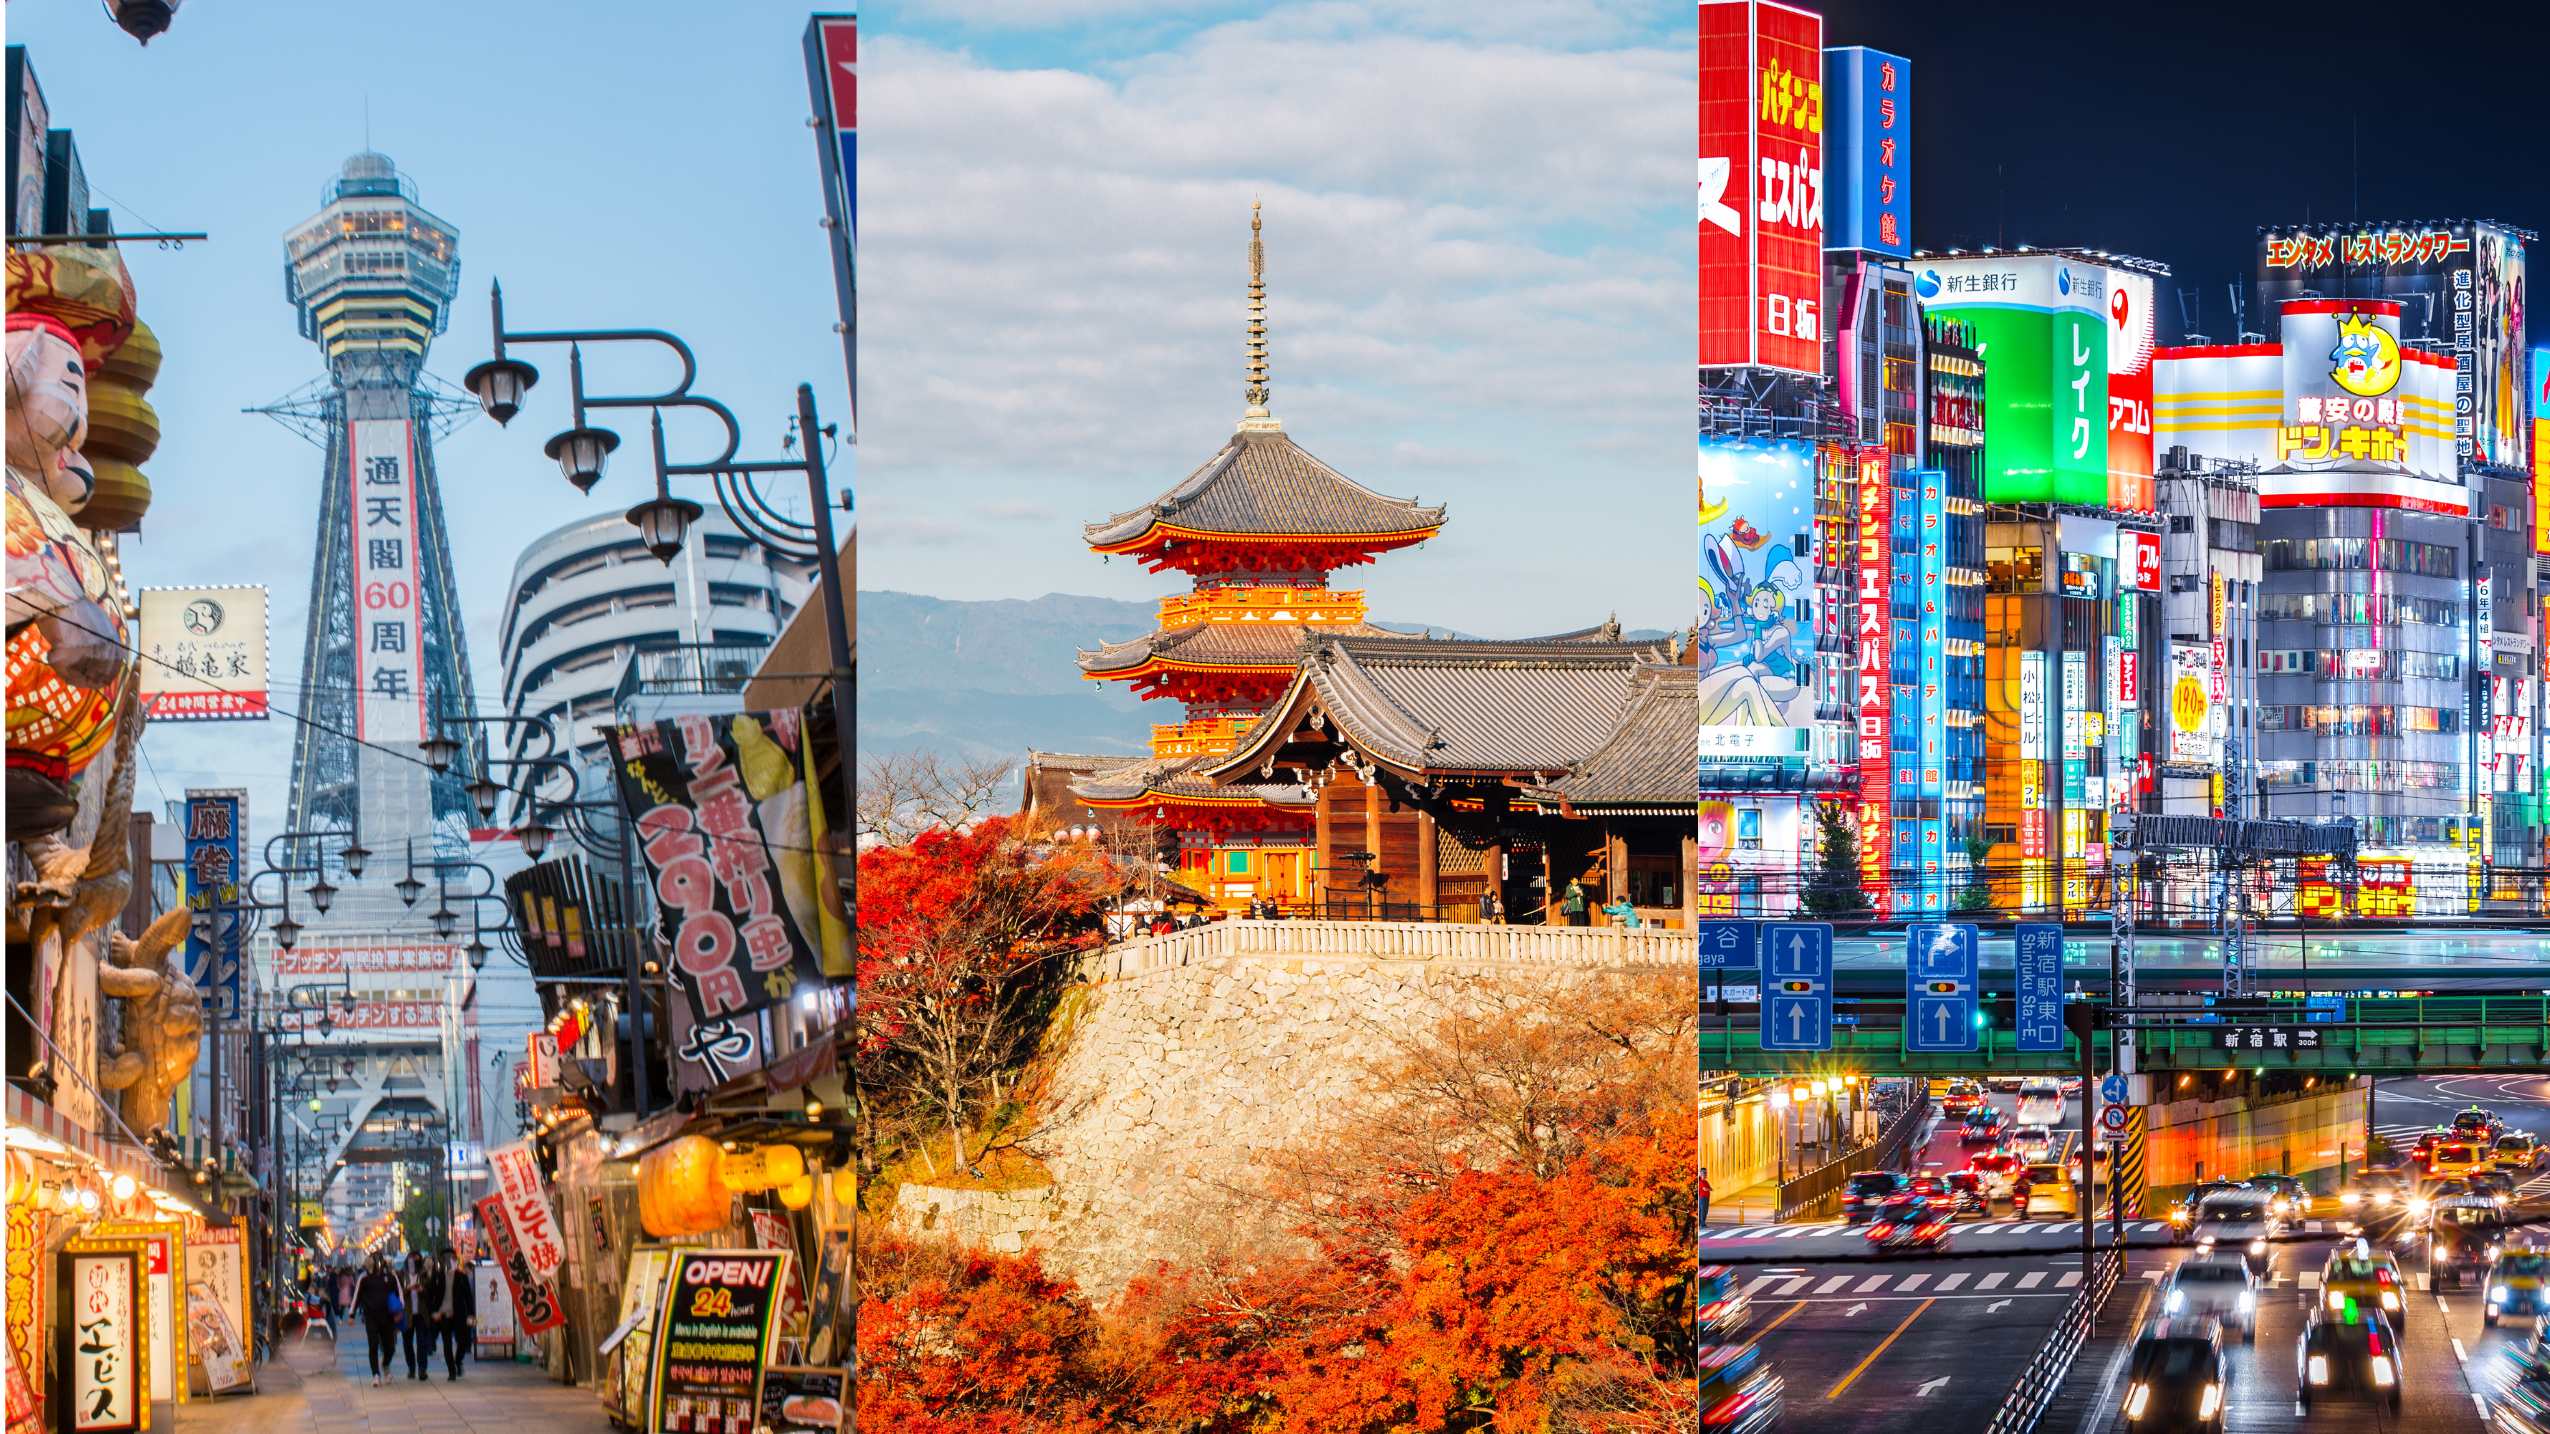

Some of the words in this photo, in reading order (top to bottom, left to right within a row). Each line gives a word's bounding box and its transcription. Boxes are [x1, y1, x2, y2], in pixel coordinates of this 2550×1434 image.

[1762, 57, 1822, 134] パチンコ
[1880, 61, 1897, 246] カラオケ館
[2266, 236, 2335, 269] エンタメ
[2340, 231, 2470, 265] レストランタワー
[1947, 273, 2018, 293] 新生銀行
[2072, 277, 2103, 300] 新生銀行
[2453, 269, 2472, 456] 進化型居酒屋の聖地
[2071, 323, 2091, 460] レイク
[2109, 396, 2151, 436] アコム
[364, 455, 410, 701] 通天閣60周年
[2479, 585, 2489, 634] 6年4組
[158, 694, 247, 711] 24時間営業中
[2023, 669, 2037, 744] 小松ビル
[1714, 734, 1755, 747] 北電子
[189, 799, 234, 885] 麻雀
[636, 803, 748, 1019] 290円
[2021, 934, 2036, 987] Shinjuku
[2036, 930, 2056, 1043] 新宿駅東口
[2225, 1032, 2288, 1048] 新宿駅
[514, 1200, 562, 1273] どて焼
[685, 1260, 773, 1288] OPEN!
[691, 1287, 731, 1318] 24
